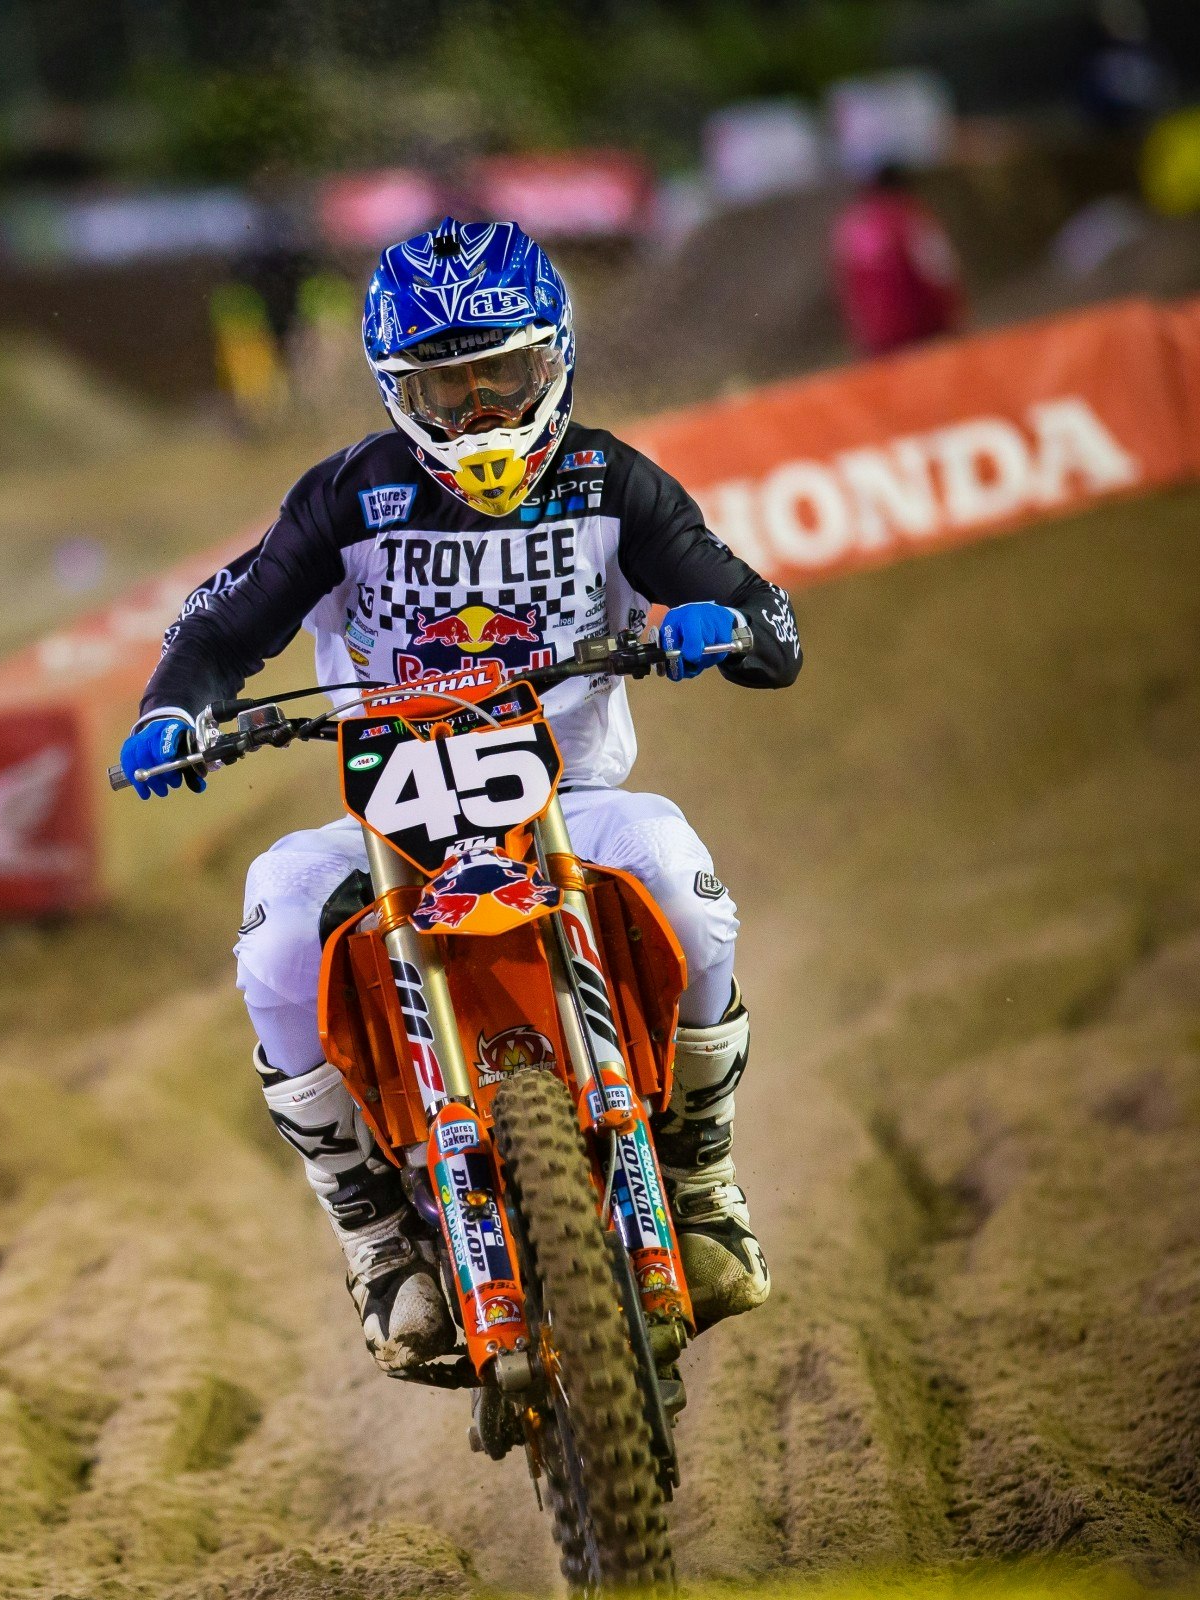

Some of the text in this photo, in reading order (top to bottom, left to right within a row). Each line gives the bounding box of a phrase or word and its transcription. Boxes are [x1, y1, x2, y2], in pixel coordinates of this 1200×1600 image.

[557, 450, 606, 474] AMA
[380, 527, 575, 587] TROY LEE
[490, 700, 521, 717] AMA
[358, 724, 392, 740] AMA
[364, 724, 551, 842] 45
[444, 835, 497, 860] KTM
[443, 1134, 475, 1149] bakery
